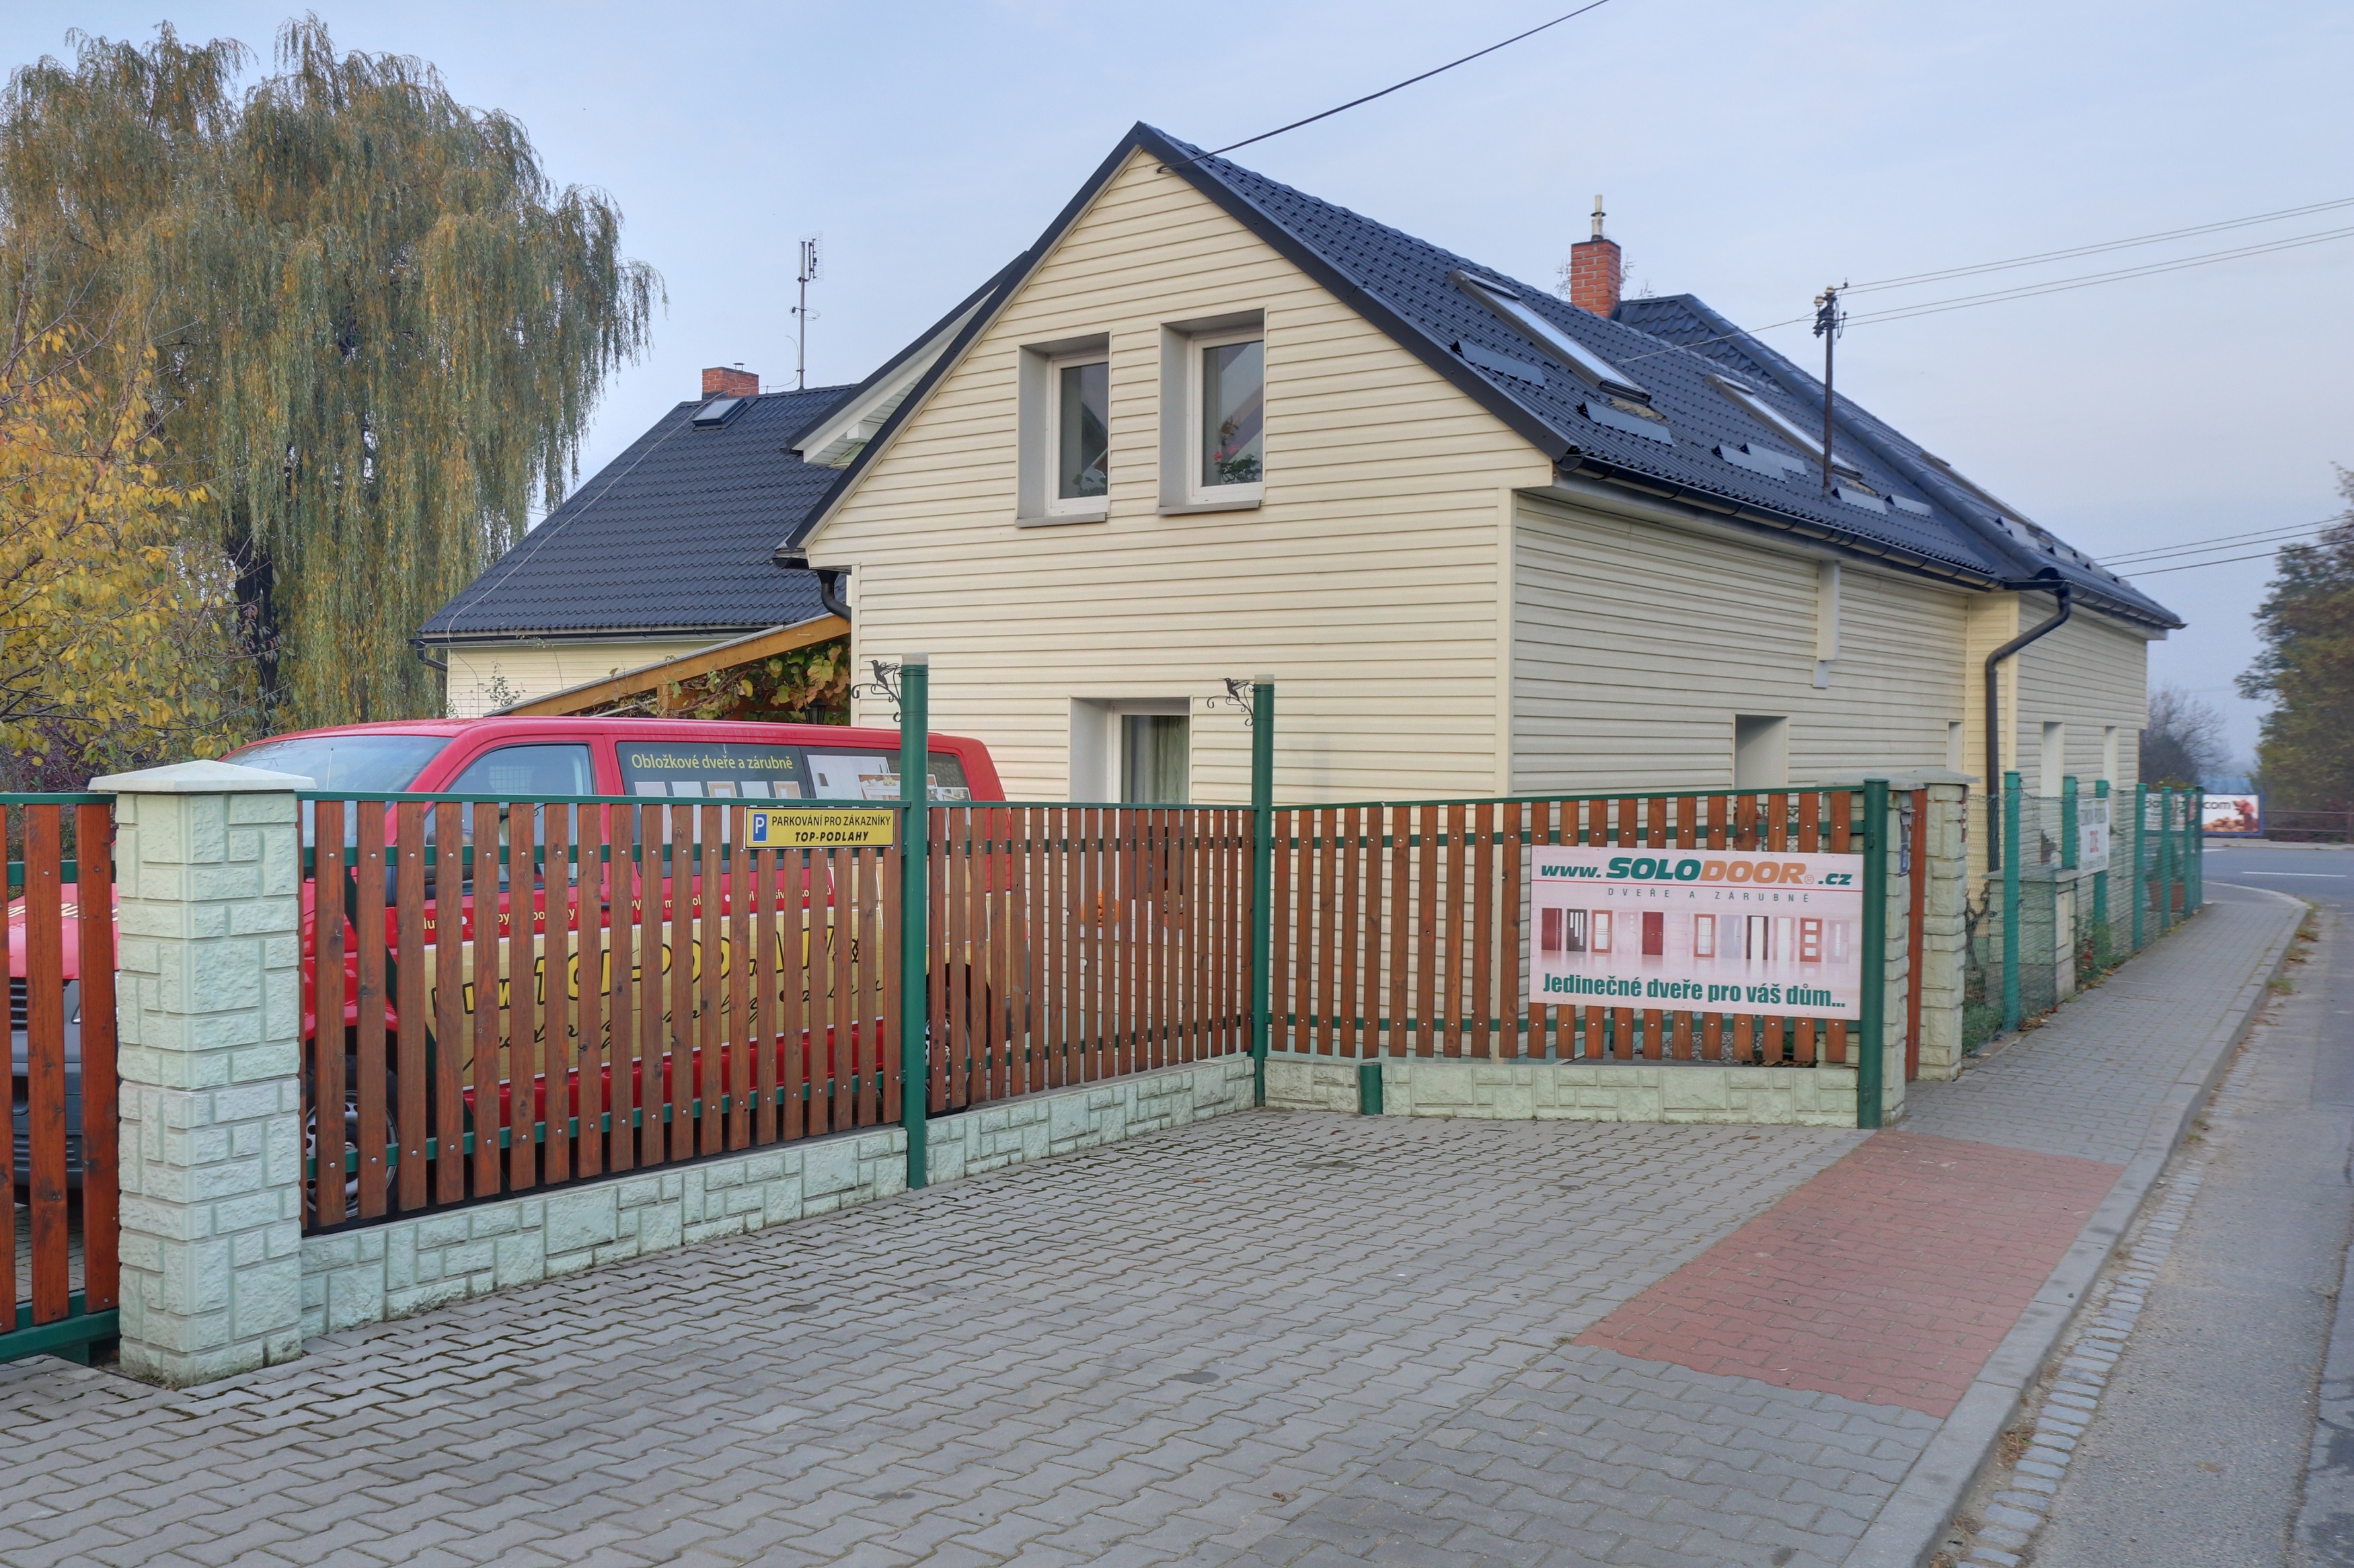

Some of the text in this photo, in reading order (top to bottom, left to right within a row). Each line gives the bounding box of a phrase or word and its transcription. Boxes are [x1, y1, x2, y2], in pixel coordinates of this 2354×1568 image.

[632, 754, 794, 769] Obložkové dveře a zárubně
[755, 816, 765, 834] P
[771, 814, 890, 826] PARKOVÁNÍ PRO ZÁKAZNÍKY
[795, 831, 869, 842] TOP-PODLAHY
[1607, 888, 1669, 898] DVEŘE
[1689, 890, 1695, 899] A
[1543, 973, 1642, 997] Jedinečné
[1646, 978, 1703, 1001] dveře
[1708, 984, 1741, 1003] pro
[1746, 982, 1782, 1005] váš
